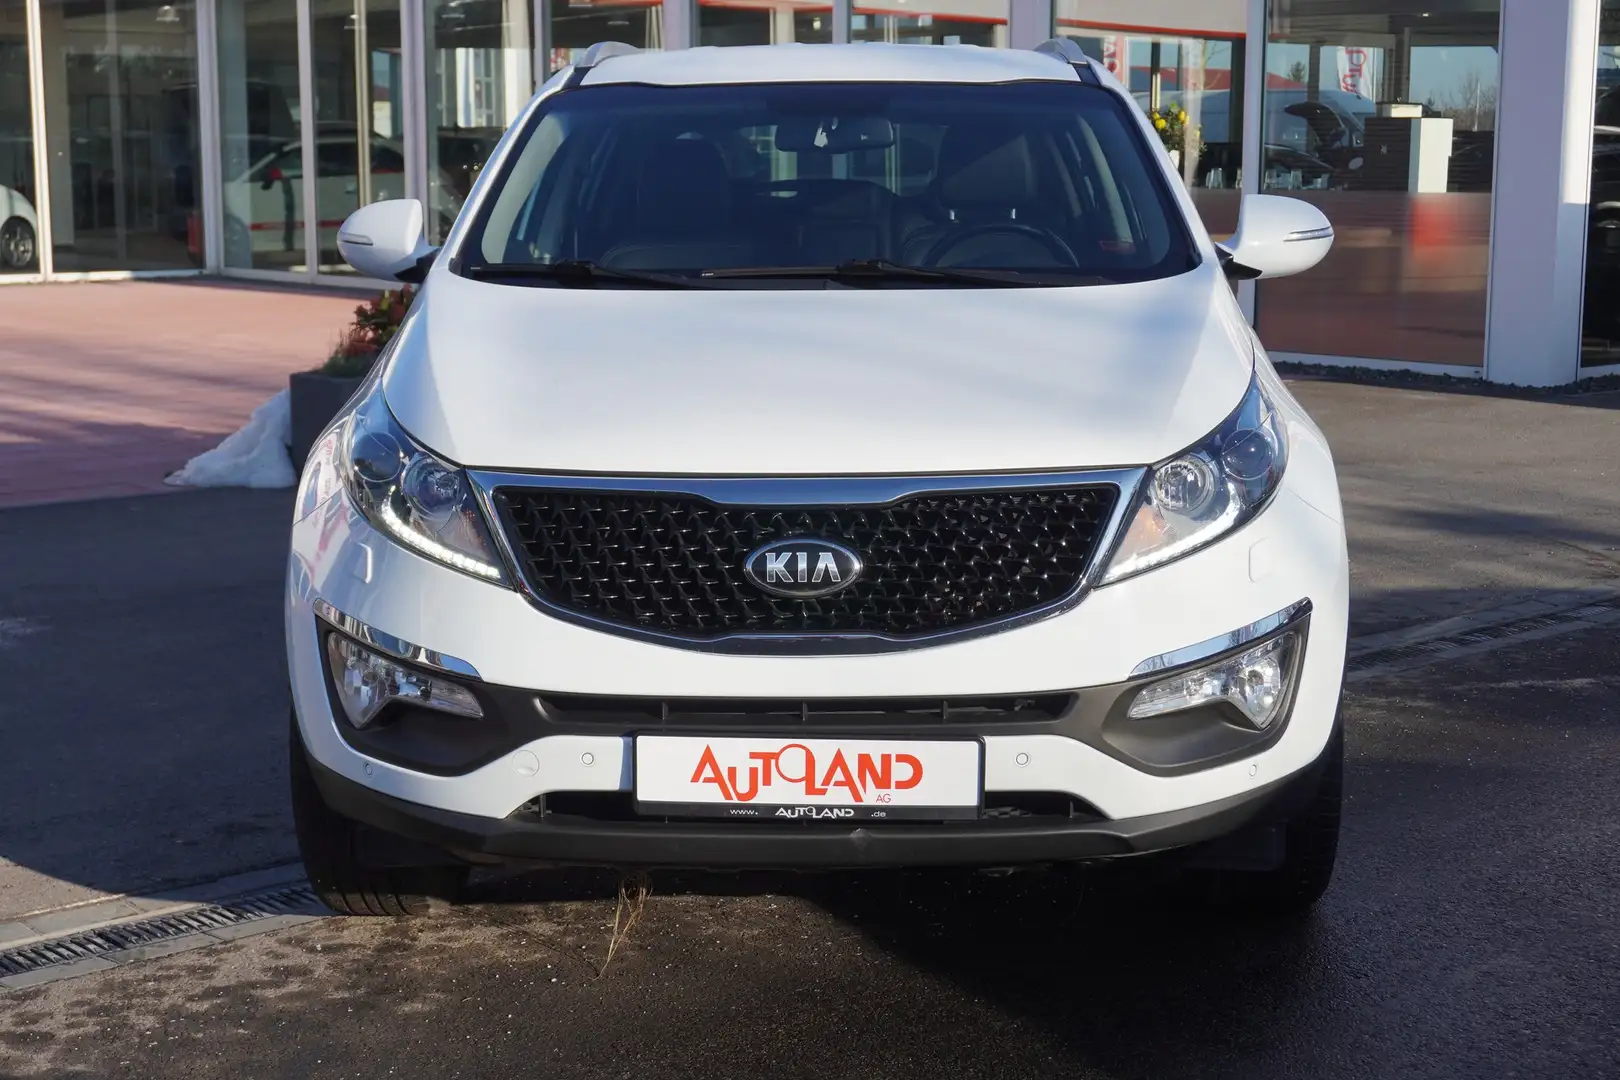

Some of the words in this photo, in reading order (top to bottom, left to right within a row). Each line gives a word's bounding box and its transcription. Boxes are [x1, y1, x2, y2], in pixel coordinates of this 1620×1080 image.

[765, 552, 841, 582] KIA
[690, 743, 923, 802] AUTOLAND
[875, 793, 892, 804] AG
[729, 808, 759, 816] www.
[774, 805, 855, 819] AUTOLAND
[870, 809, 887, 818] .de
